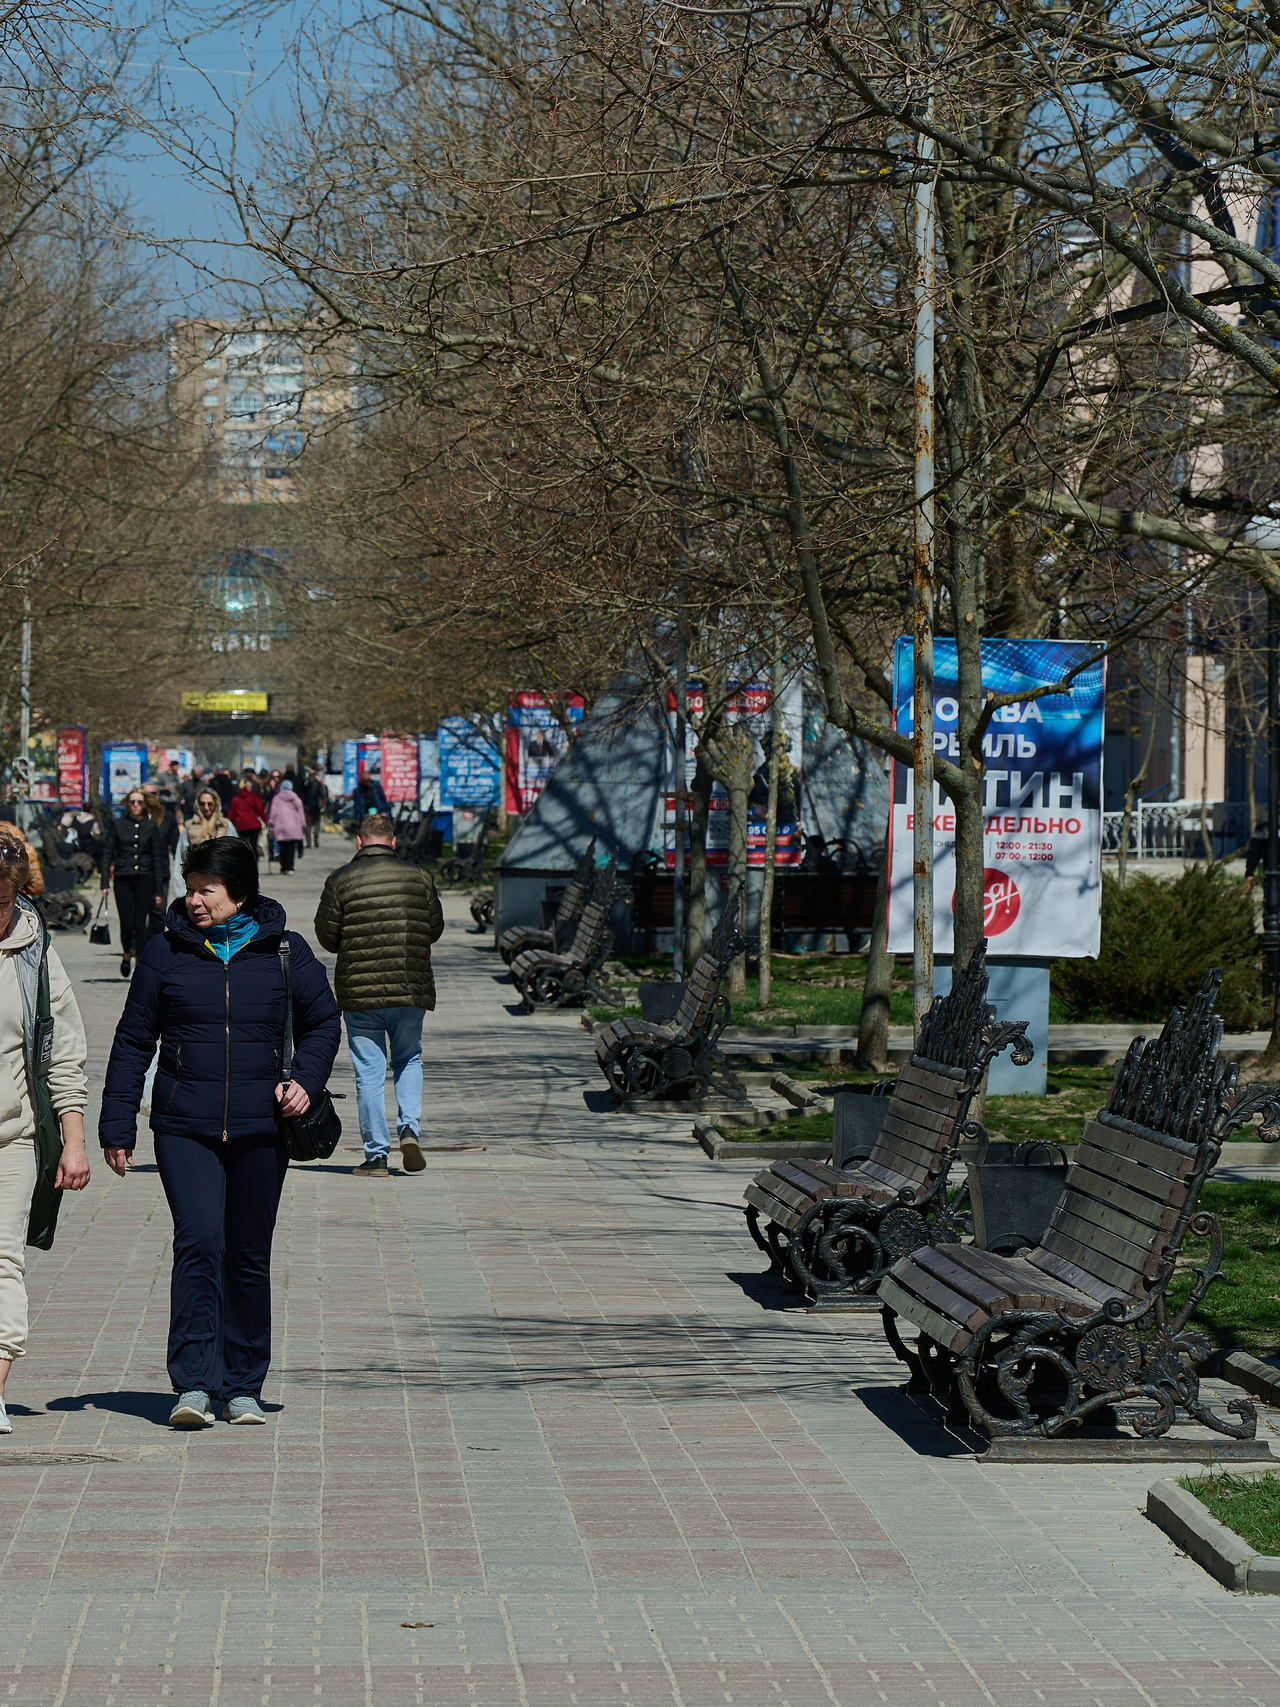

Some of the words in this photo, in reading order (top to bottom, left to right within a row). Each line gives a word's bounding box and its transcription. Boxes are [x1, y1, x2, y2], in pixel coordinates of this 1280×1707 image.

[995, 841, 1021, 850] 12:00
[1028, 842, 1053, 851] 21:30
[995, 852, 1021, 860] 07:00
[1028, 853, 1053, 861] 12:00
